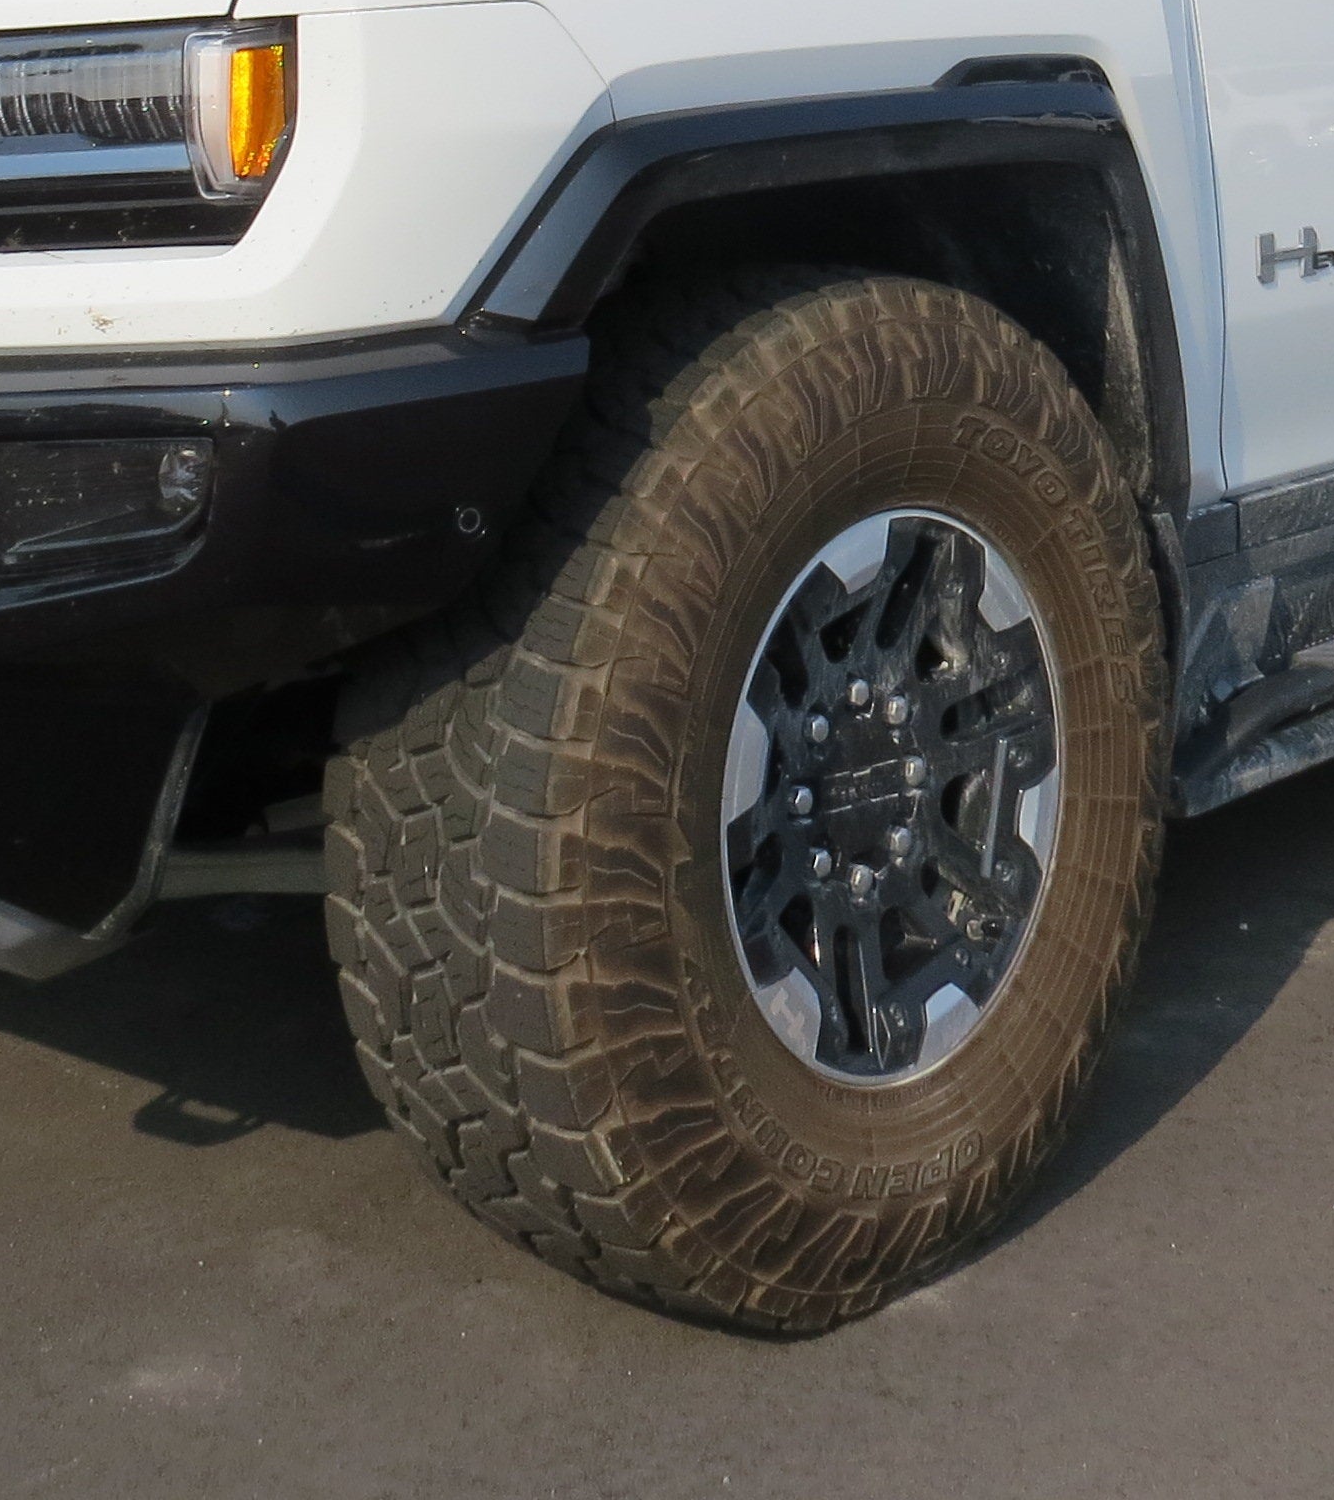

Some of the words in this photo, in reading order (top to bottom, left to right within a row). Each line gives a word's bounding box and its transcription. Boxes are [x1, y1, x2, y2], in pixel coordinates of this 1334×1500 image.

[953, 411, 1068, 505] TOYO
[1065, 506, 1138, 704] TIRES
[851, 1130, 983, 1200] OPEN
